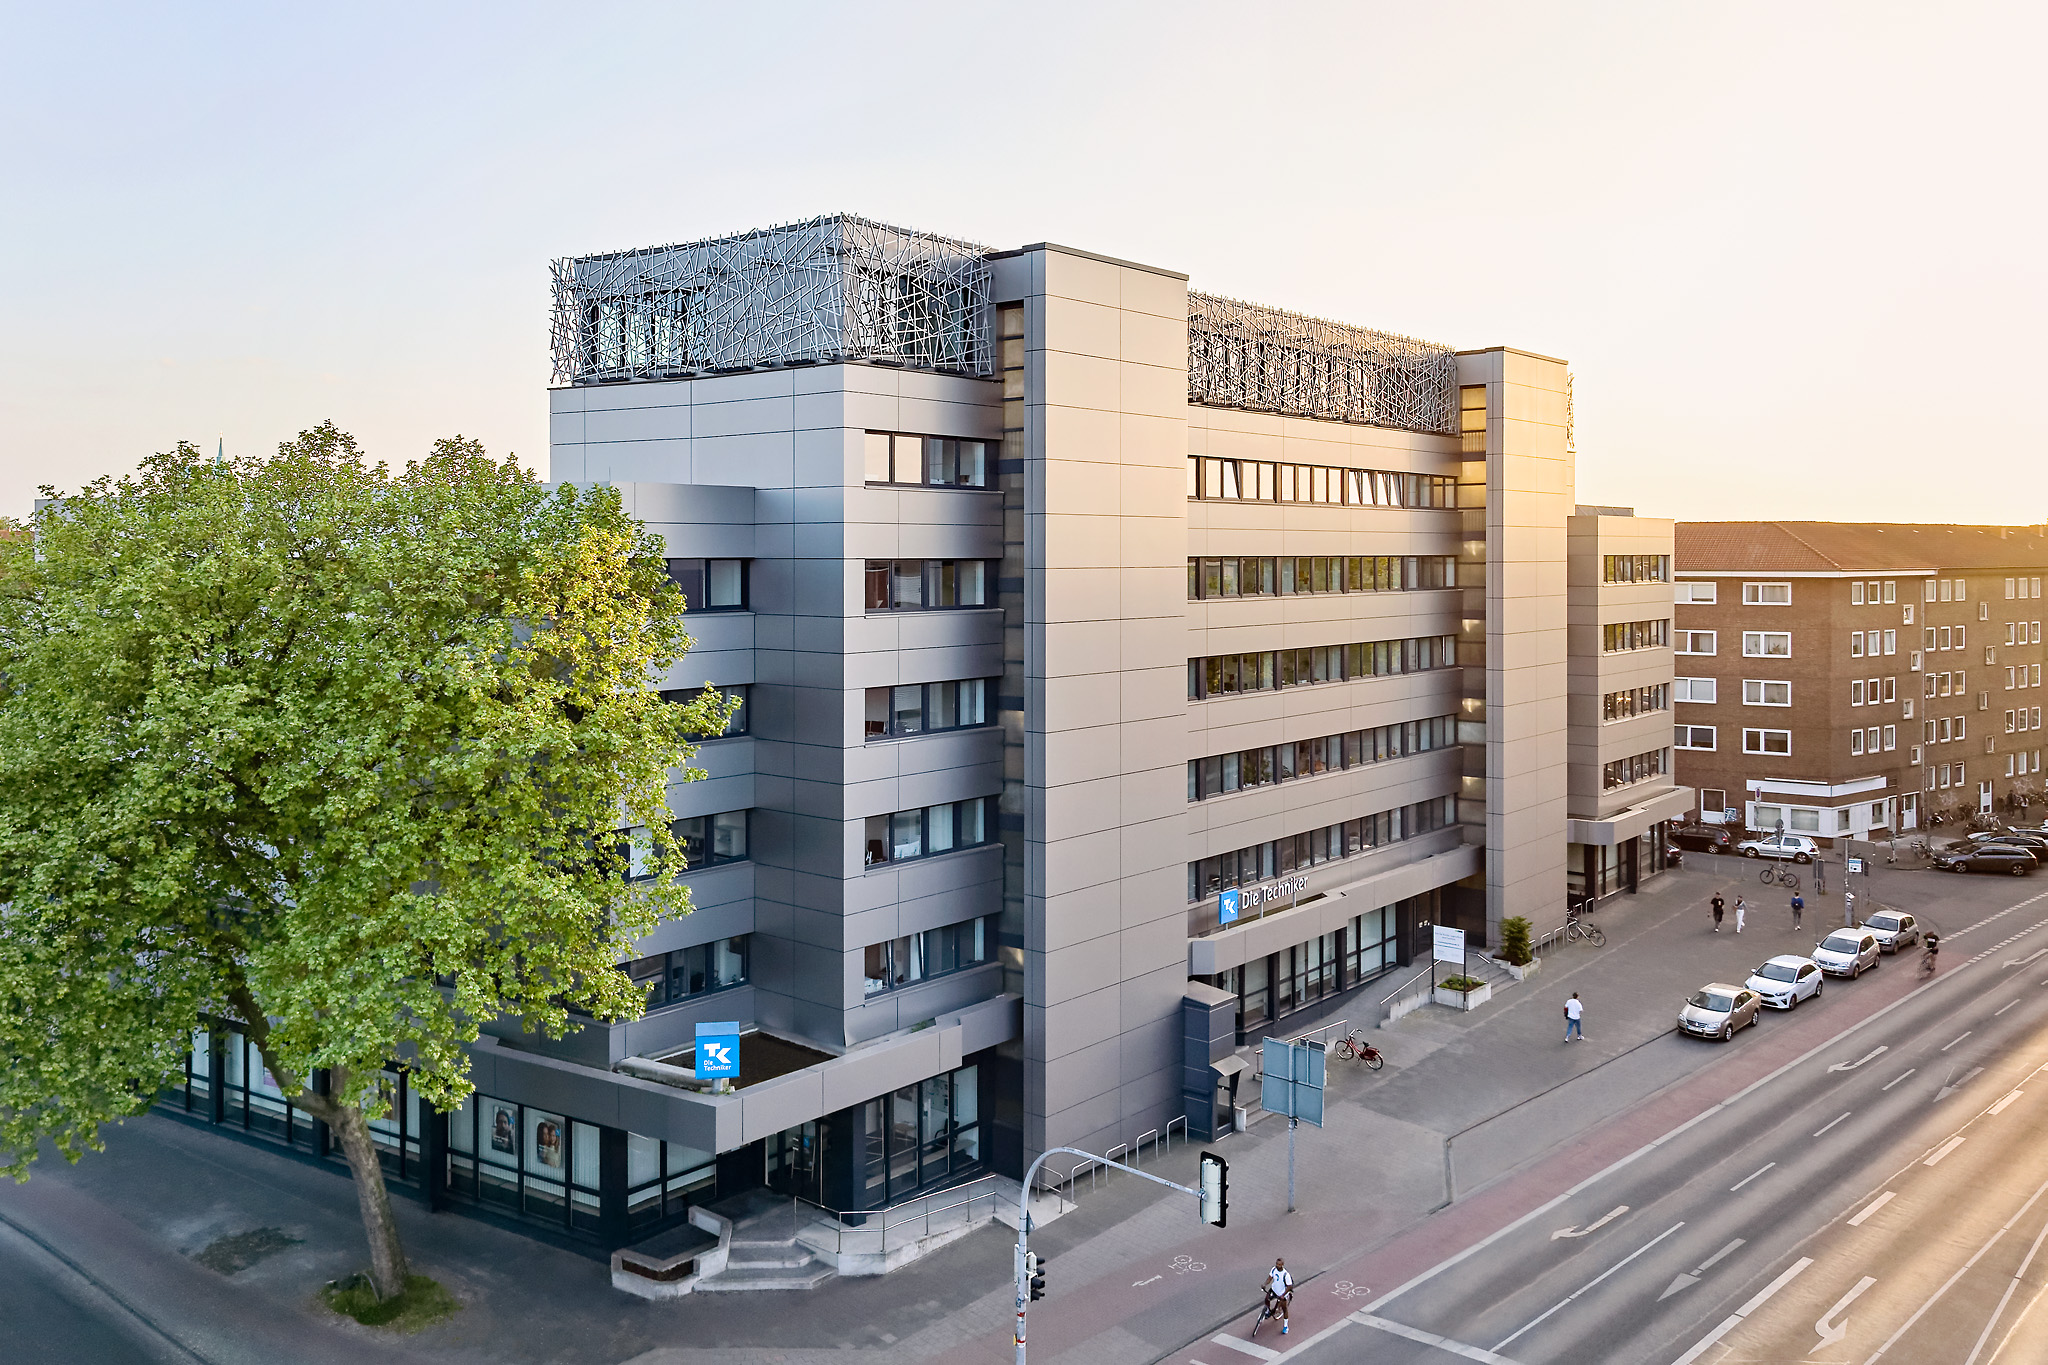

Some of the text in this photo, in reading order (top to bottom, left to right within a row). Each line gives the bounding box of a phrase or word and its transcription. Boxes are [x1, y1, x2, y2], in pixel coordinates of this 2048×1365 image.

[1242, 876, 1309, 910] Die Techniker
[1223, 898, 1236, 914] TK
[704, 1043, 731, 1064] TK
